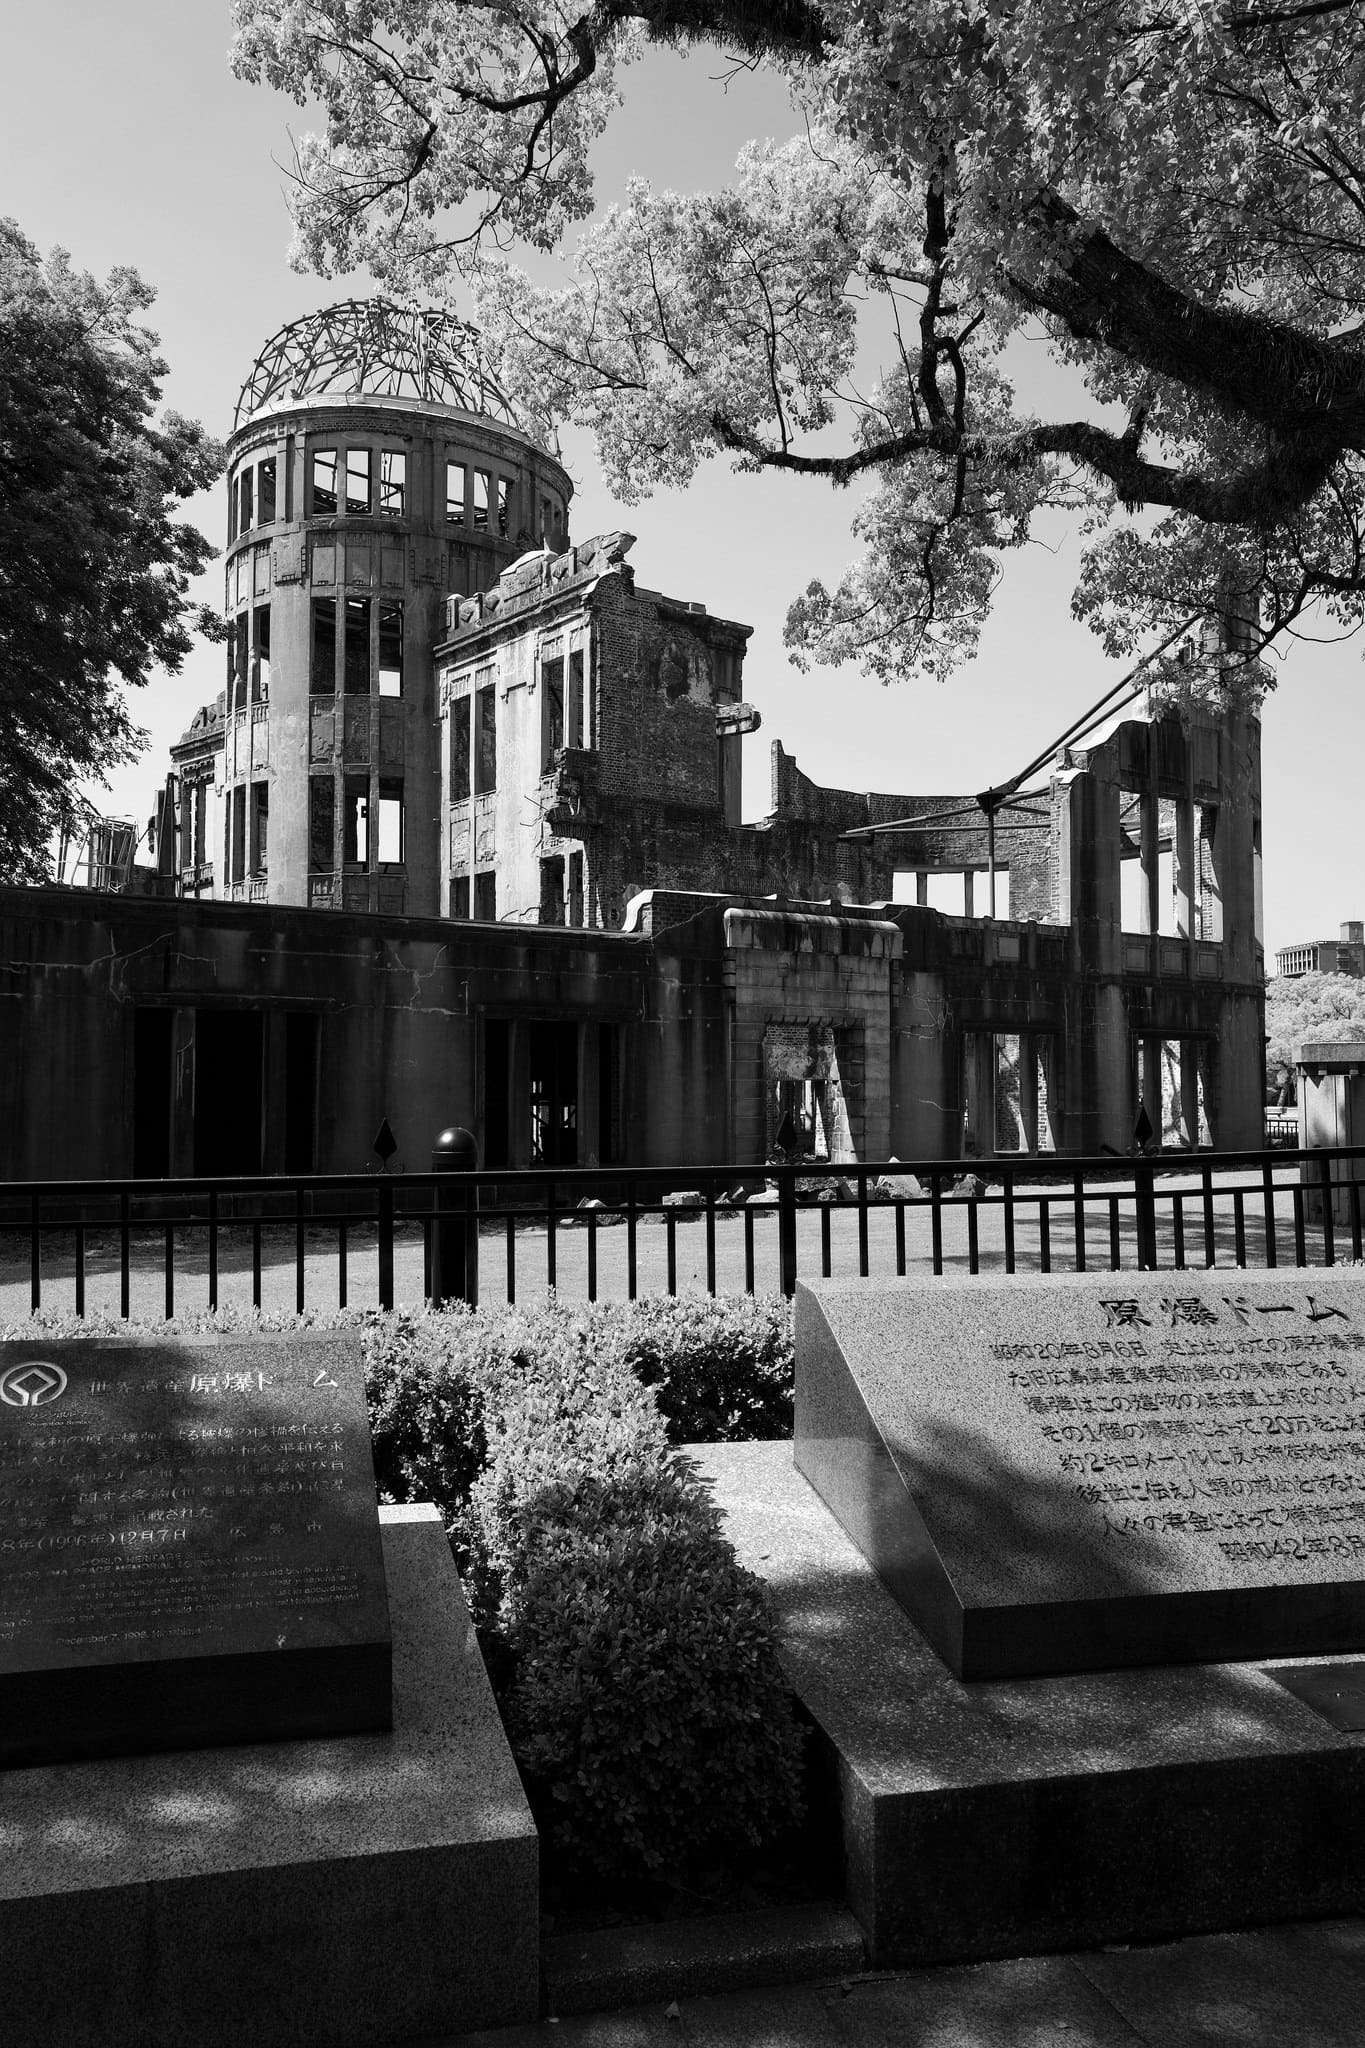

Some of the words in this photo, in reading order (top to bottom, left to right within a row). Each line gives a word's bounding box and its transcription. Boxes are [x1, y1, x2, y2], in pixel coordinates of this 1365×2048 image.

[1099, 1296, 1350, 1327] 原爆ドーム
[990, 1340, 1148, 1360] 昭和20年8月6日
